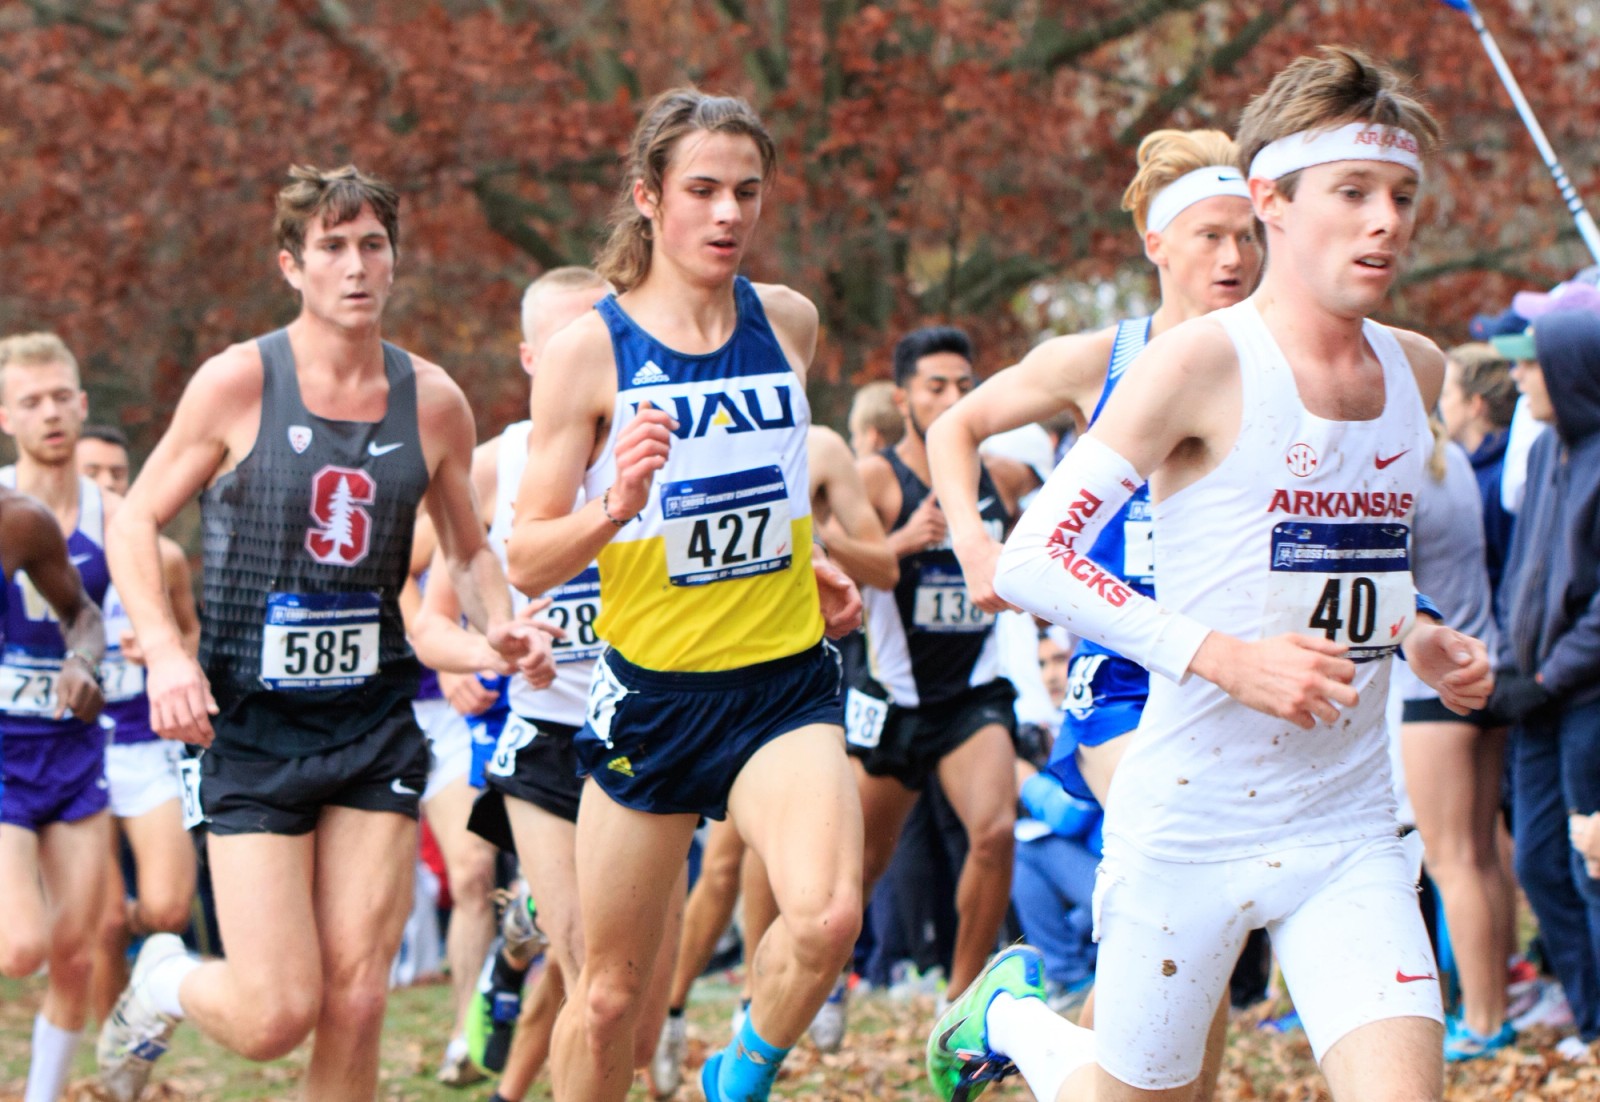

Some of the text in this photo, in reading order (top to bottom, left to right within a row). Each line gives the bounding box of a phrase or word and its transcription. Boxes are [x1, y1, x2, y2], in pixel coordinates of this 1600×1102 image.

[630, 385, 796, 440] NAU
[1266, 489, 1414, 518] ARKANSAS
[688, 507, 771, 568] 427
[1308, 577, 1377, 643] 40
[284, 629, 362, 675] 585
